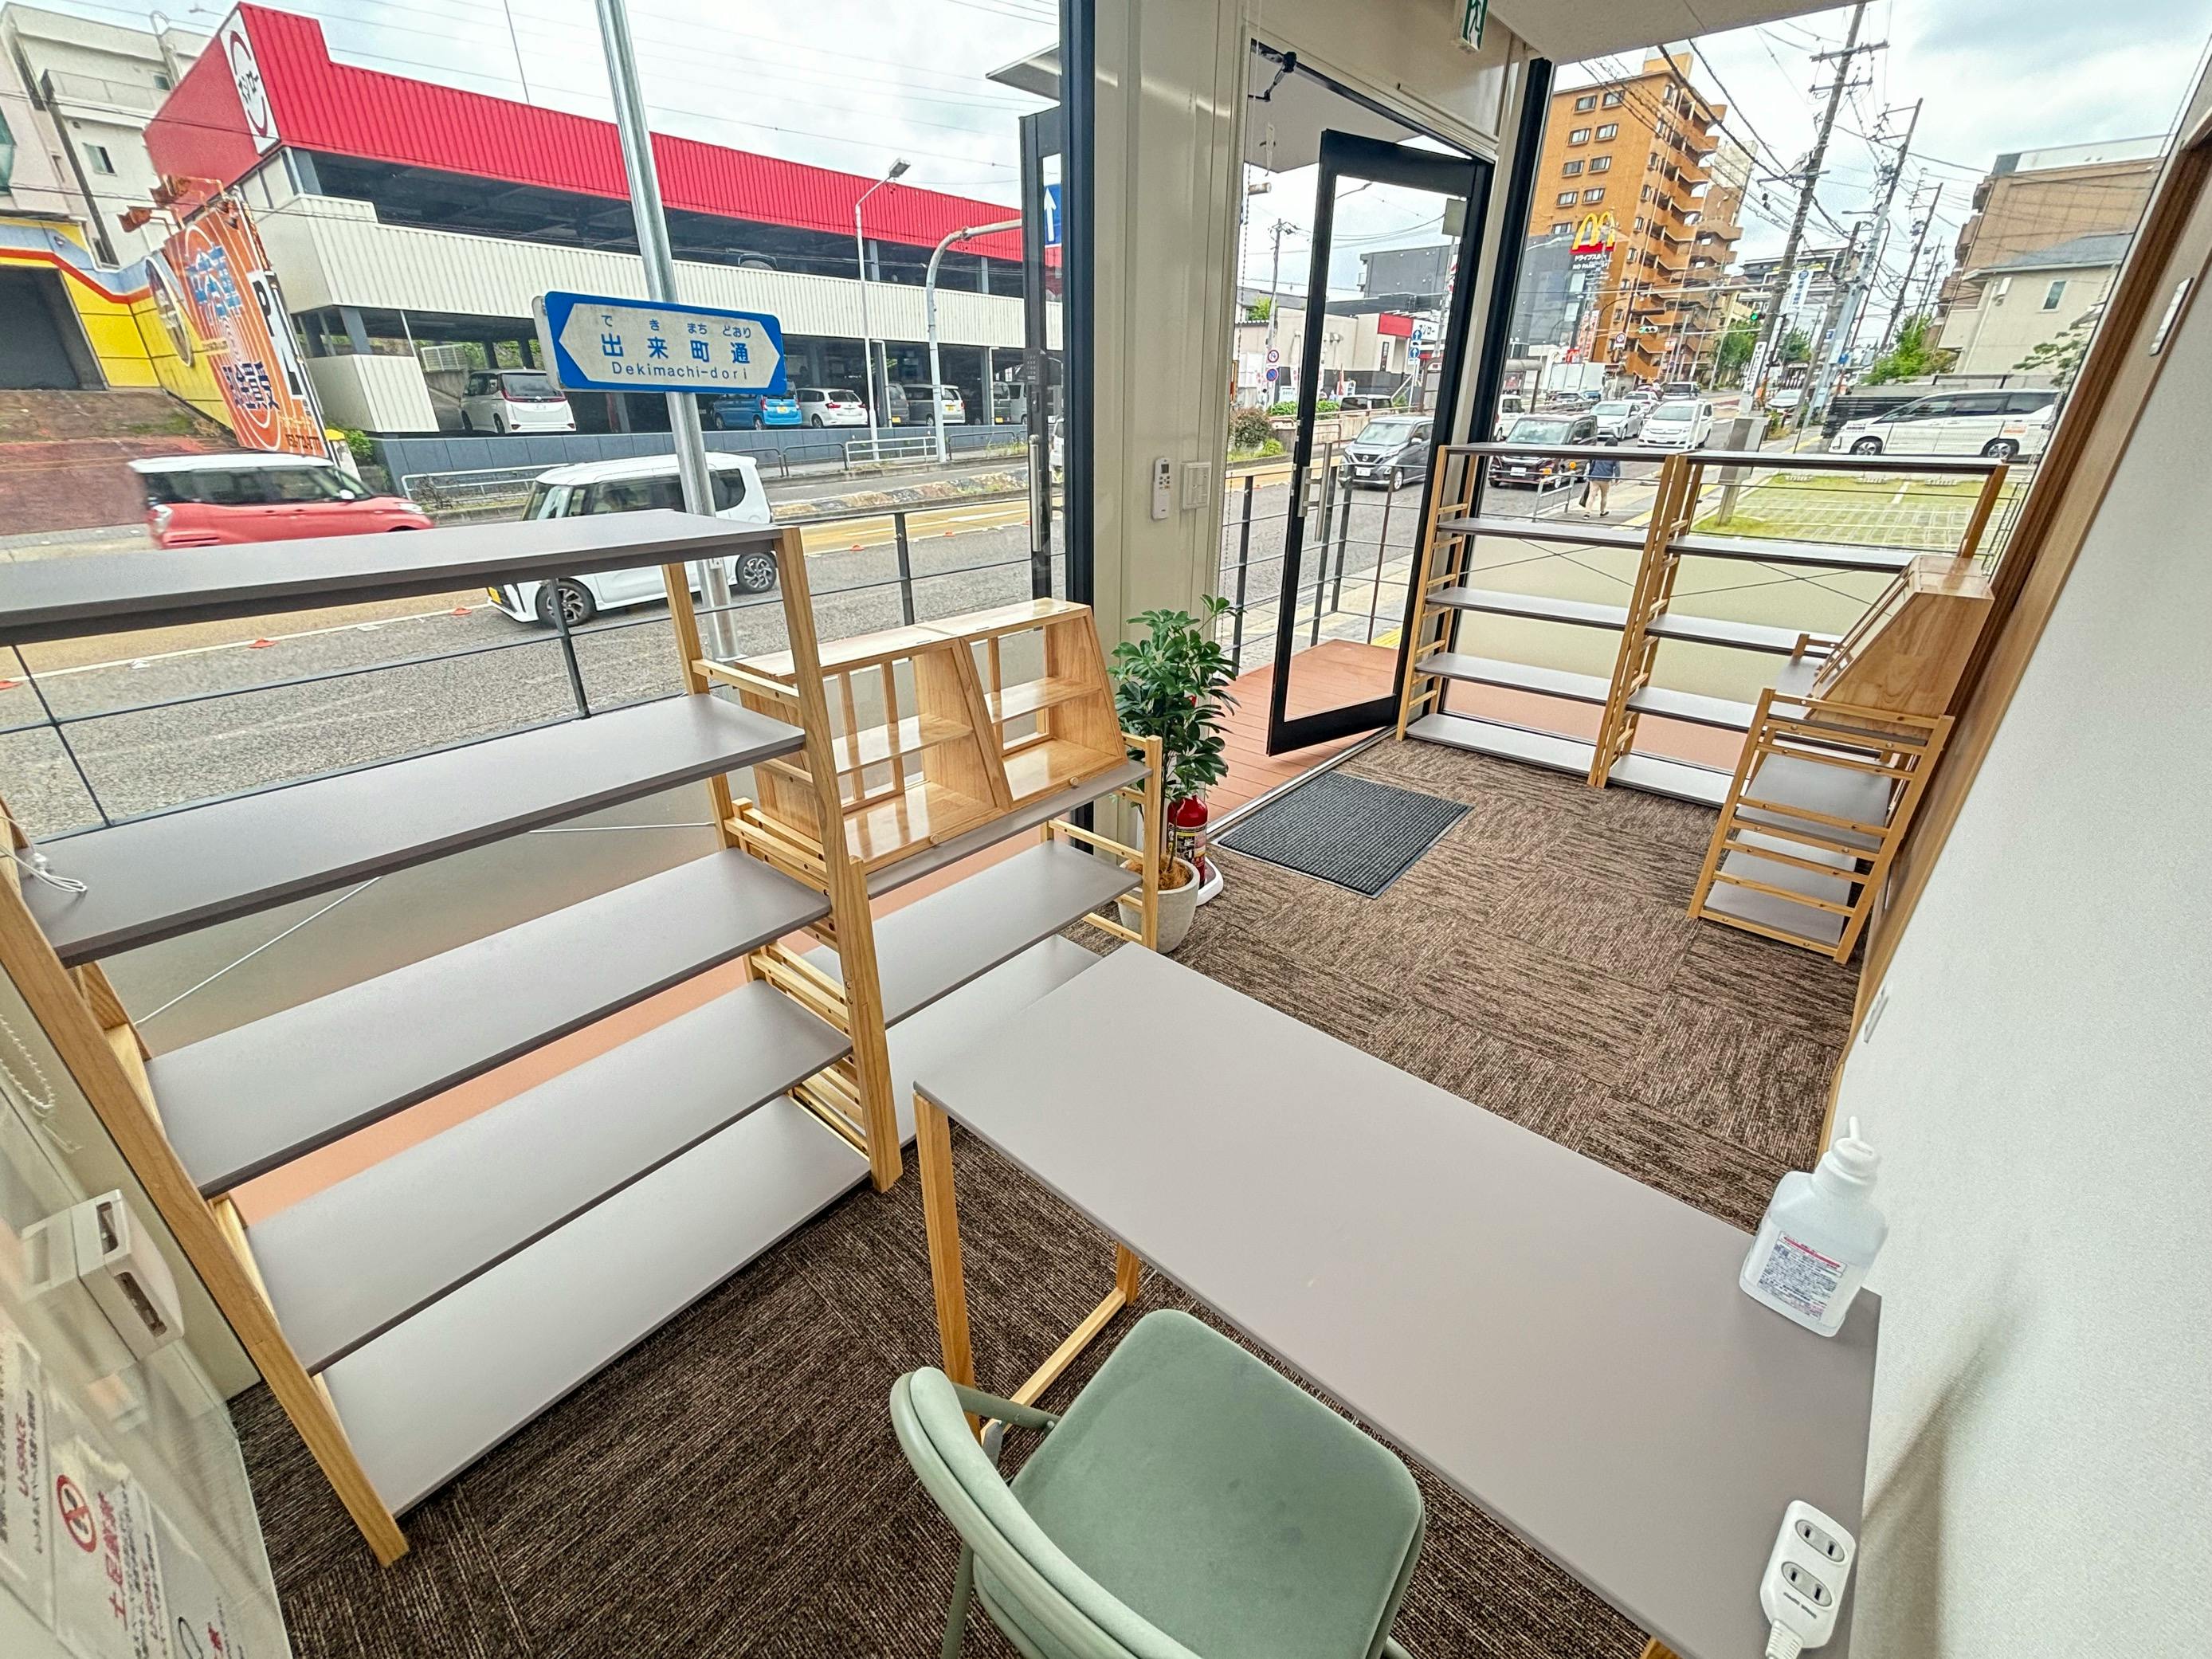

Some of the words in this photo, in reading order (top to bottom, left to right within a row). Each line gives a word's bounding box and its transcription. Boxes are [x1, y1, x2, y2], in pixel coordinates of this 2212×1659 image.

[601, 332, 750, 363] 出来町通
[611, 362, 747, 379] Dekimachi-dori
